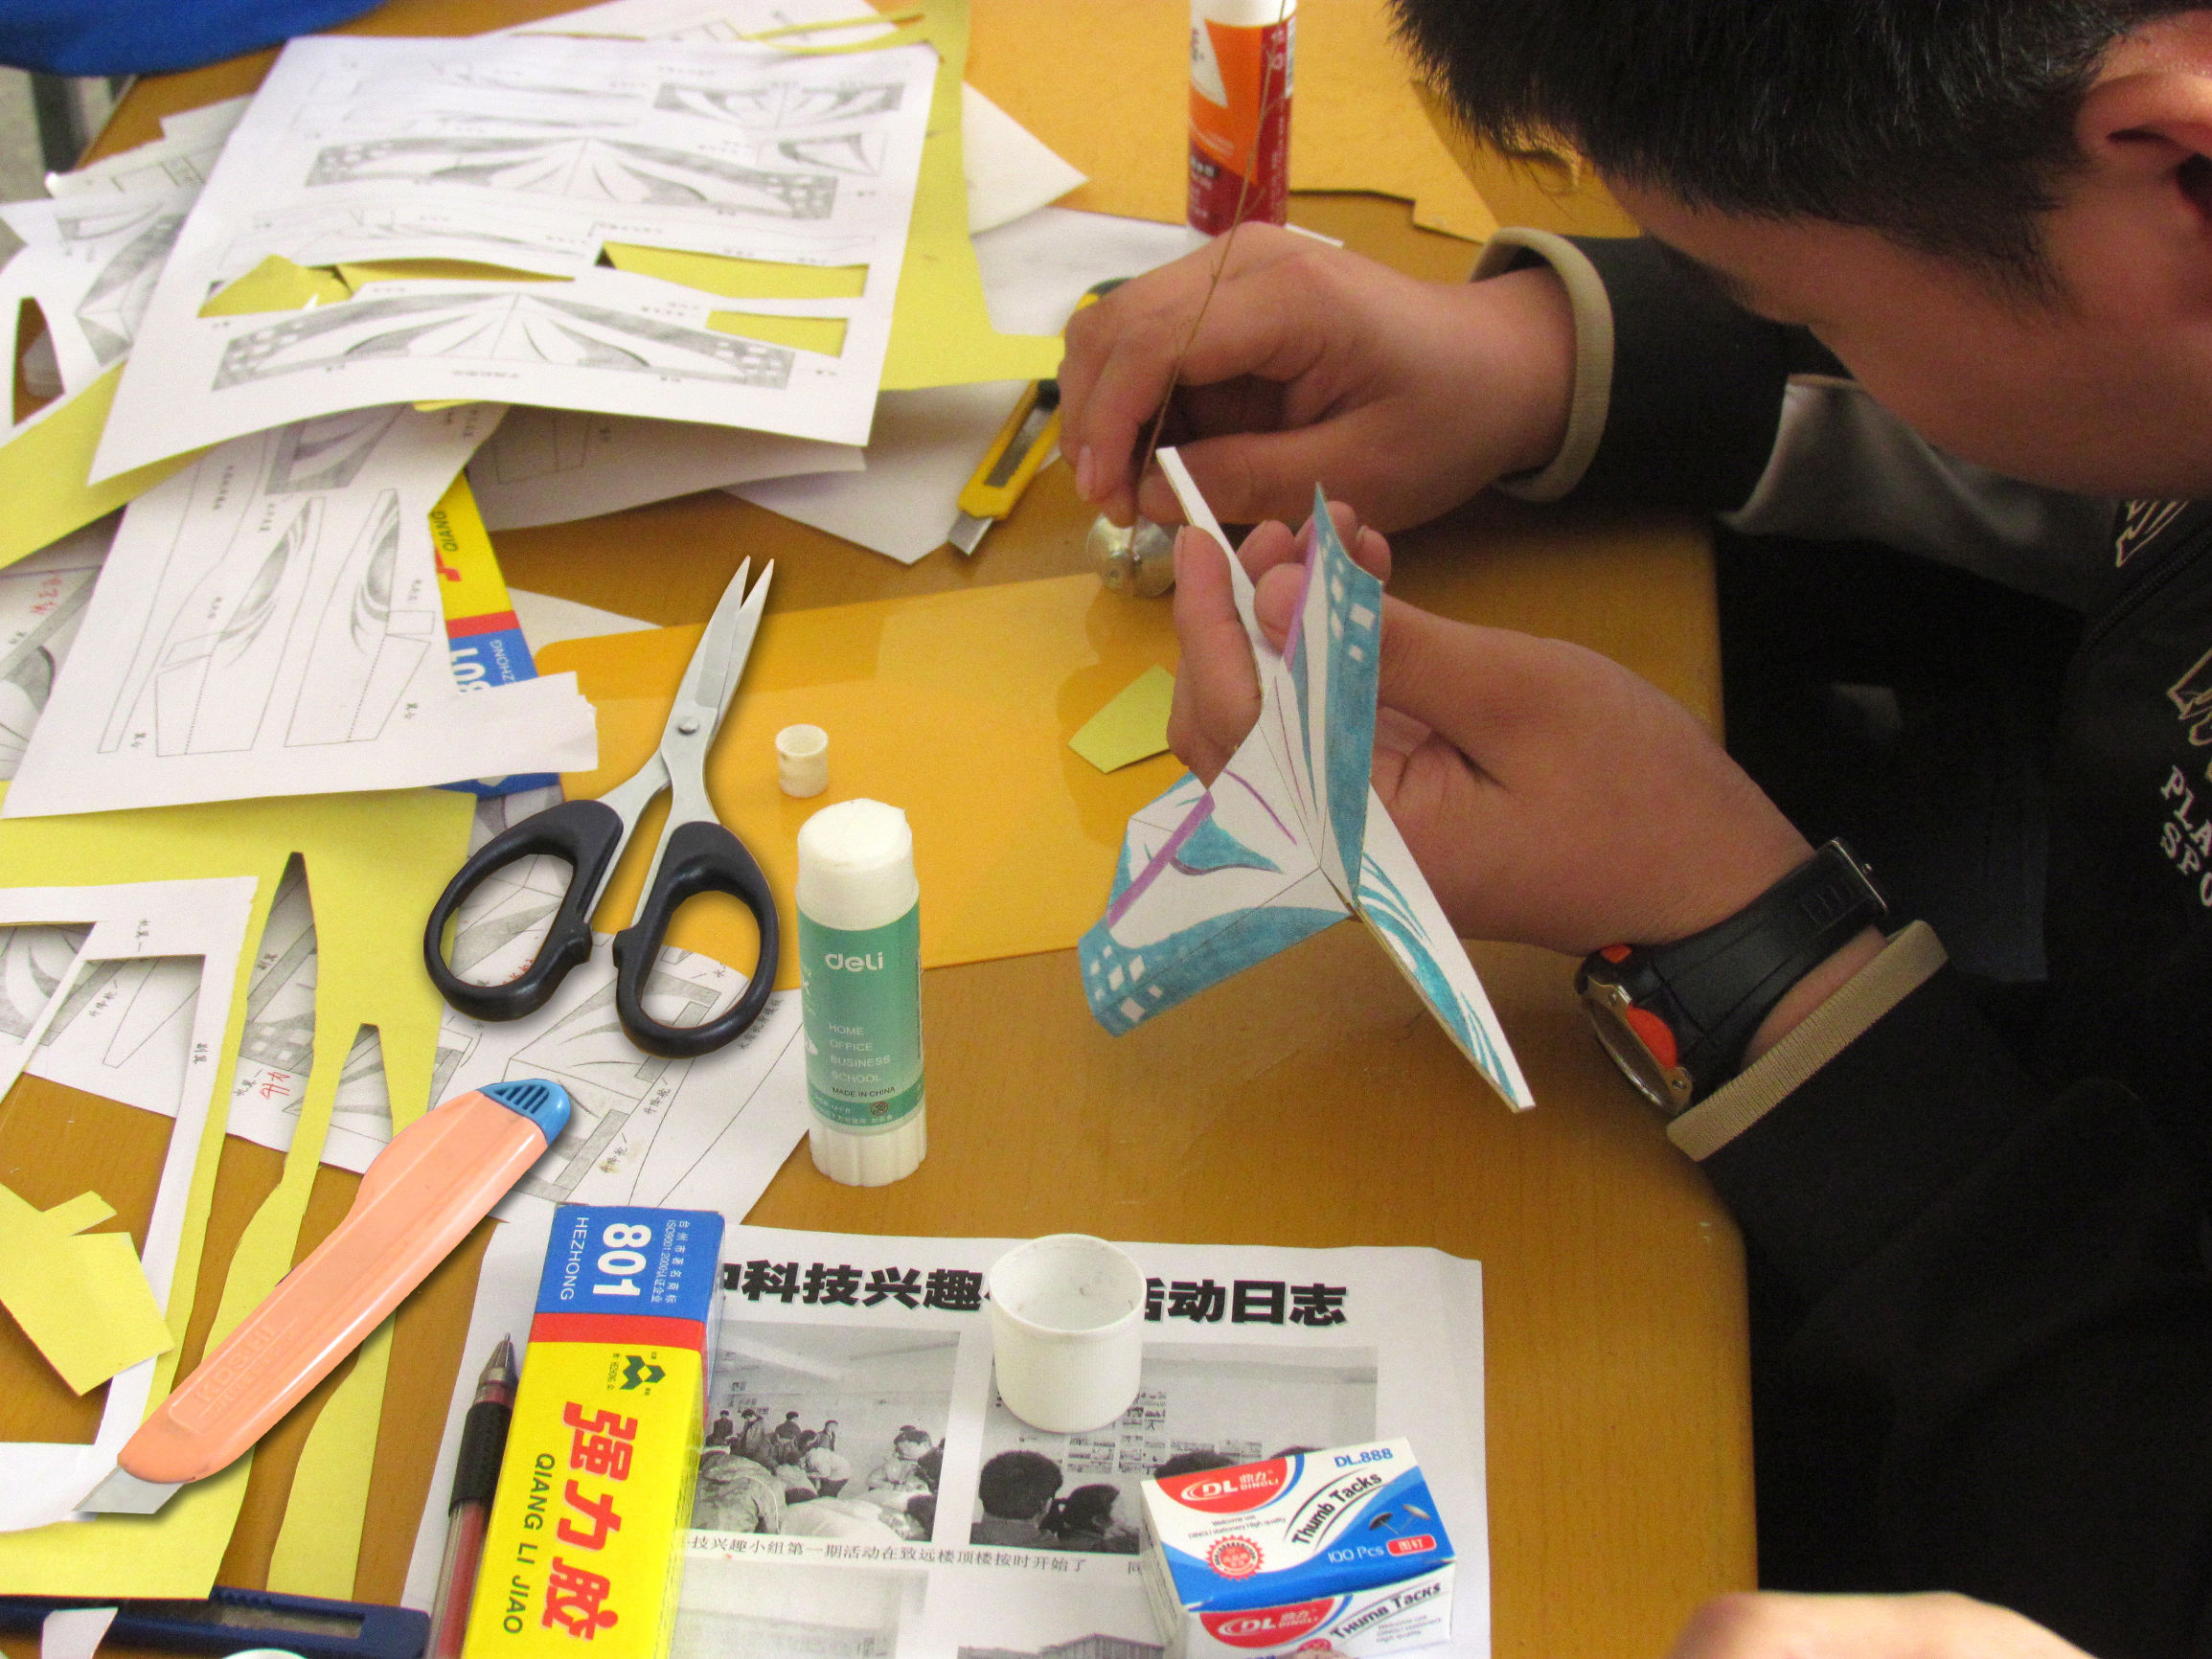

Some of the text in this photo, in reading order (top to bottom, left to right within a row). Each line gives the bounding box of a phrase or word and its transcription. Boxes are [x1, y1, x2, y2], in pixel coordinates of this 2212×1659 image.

[431, 511, 458, 553] QIANG
[825, 951, 885, 972] deli
[829, 1022, 864, 1035] HOME
[830, 1038, 874, 1052] OFFICE
[831, 1055, 891, 1068] BUSINESS
[832, 1072, 882, 1083] SCHOOL
[832, 1086, 856, 1098] MADE
[869, 1086, 896, 1098] CHINA
[560, 1217, 589, 1301] HEZHONG
[593, 1223, 652, 1296] 801
[1334, 1447, 1394, 1467] DL.888
[1202, 1480, 1239, 1496] DL
[1291, 1473, 1382, 1545] Thumb Tacks
[541, 1401, 638, 1641] 强力胶
[503, 1453, 556, 1634] QIANG LI JIAO
[688, 1534, 1087, 1574] 技兴趣小组第一期活动在致远楼顶楼按时开始了
[1327, 1545, 1385, 1563] 100 Pcs
